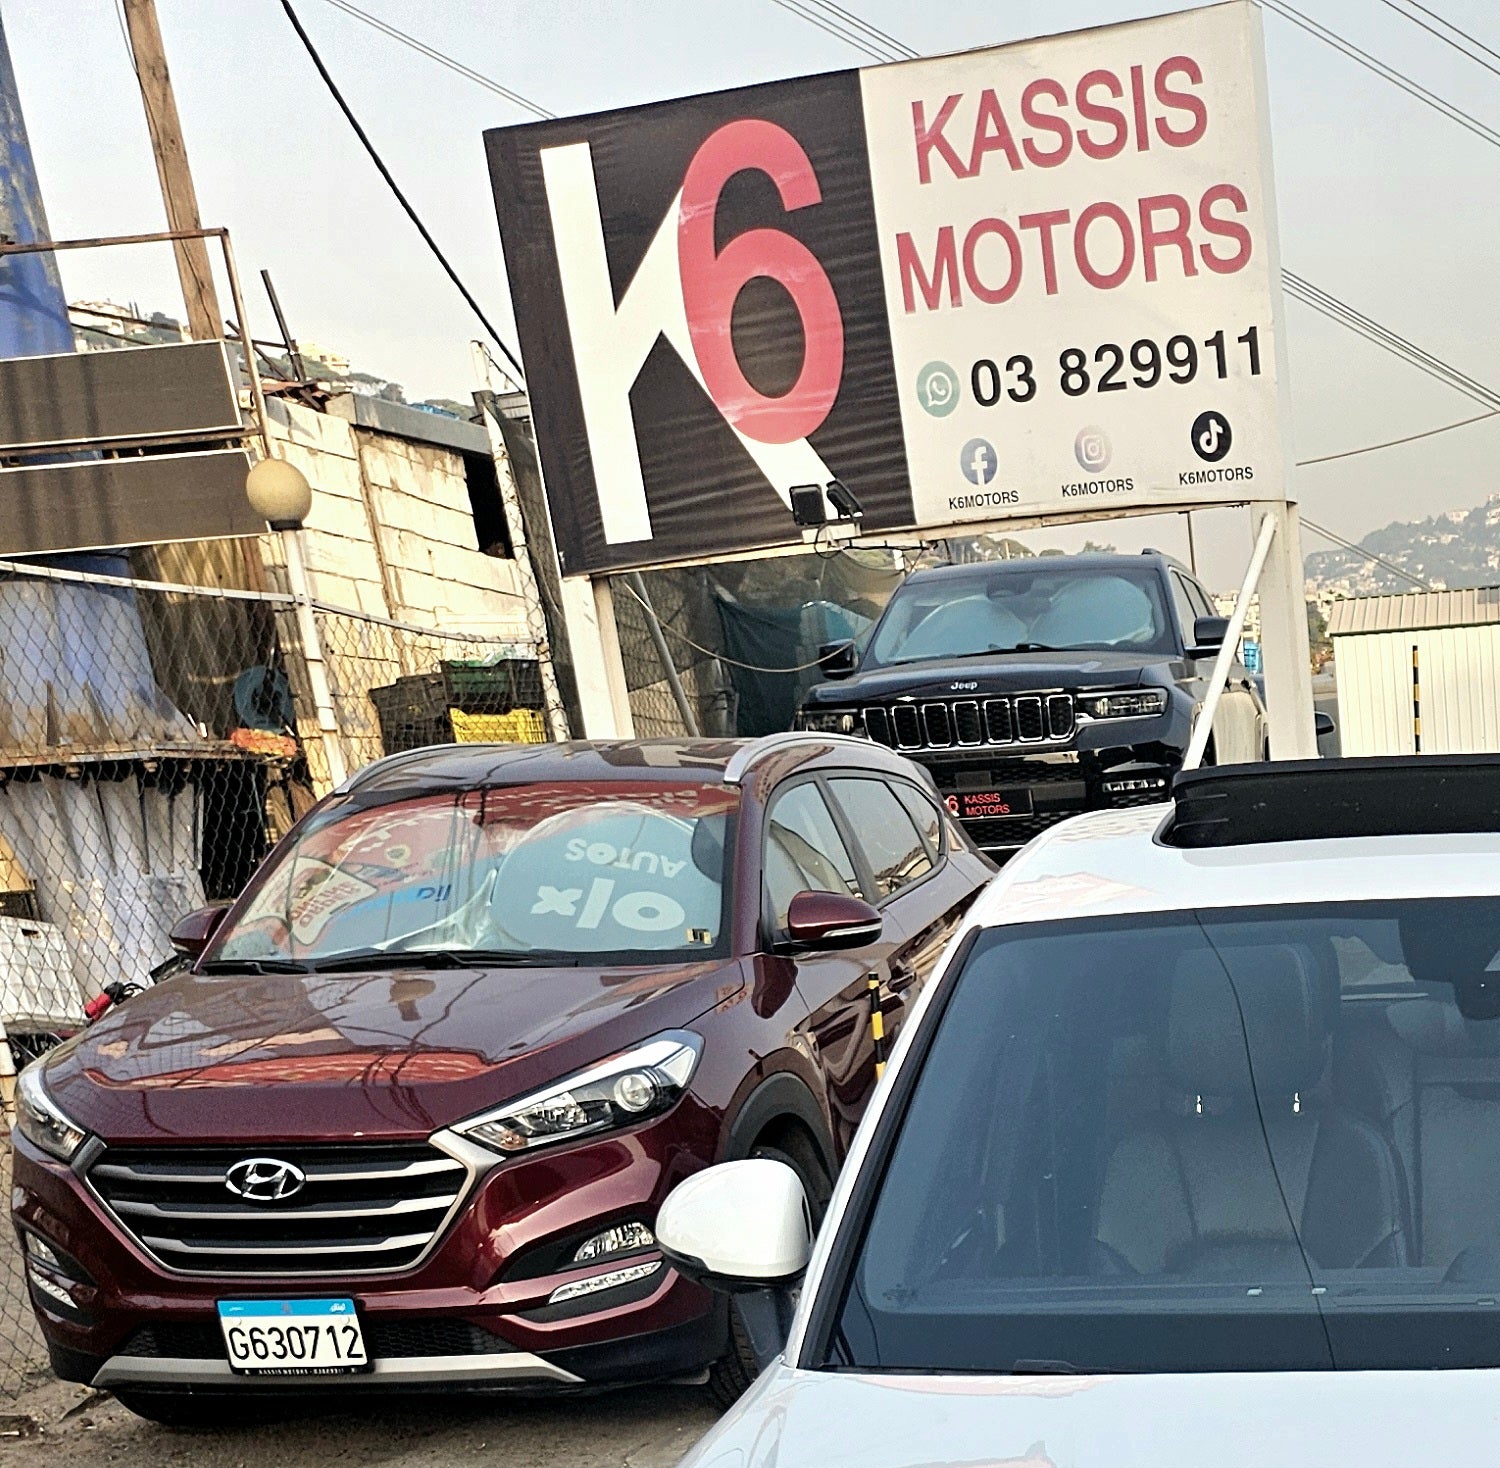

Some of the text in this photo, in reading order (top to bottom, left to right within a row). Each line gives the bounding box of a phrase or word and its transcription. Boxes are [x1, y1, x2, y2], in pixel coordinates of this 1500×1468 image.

[911, 55, 1208, 184] KASSIS
[896, 184, 1252, 314] MOTORS
[540, 118, 845, 544] K6
[971, 326, 1261, 407] 03 829911
[1061, 478, 1134, 498] K6MOTORS
[1179, 466, 1254, 486] K6MOTORS
[948, 490, 1020, 511] K6MOTORS
[950, 681, 978, 690] Jeep
[963, 793, 1001, 805] KASSIS
[965, 804, 1011, 815] MOTORS
[564, 837, 688, 879] AUTOS
[530, 876, 686, 932] olx
[228, 1325, 364, 1360] G630712
